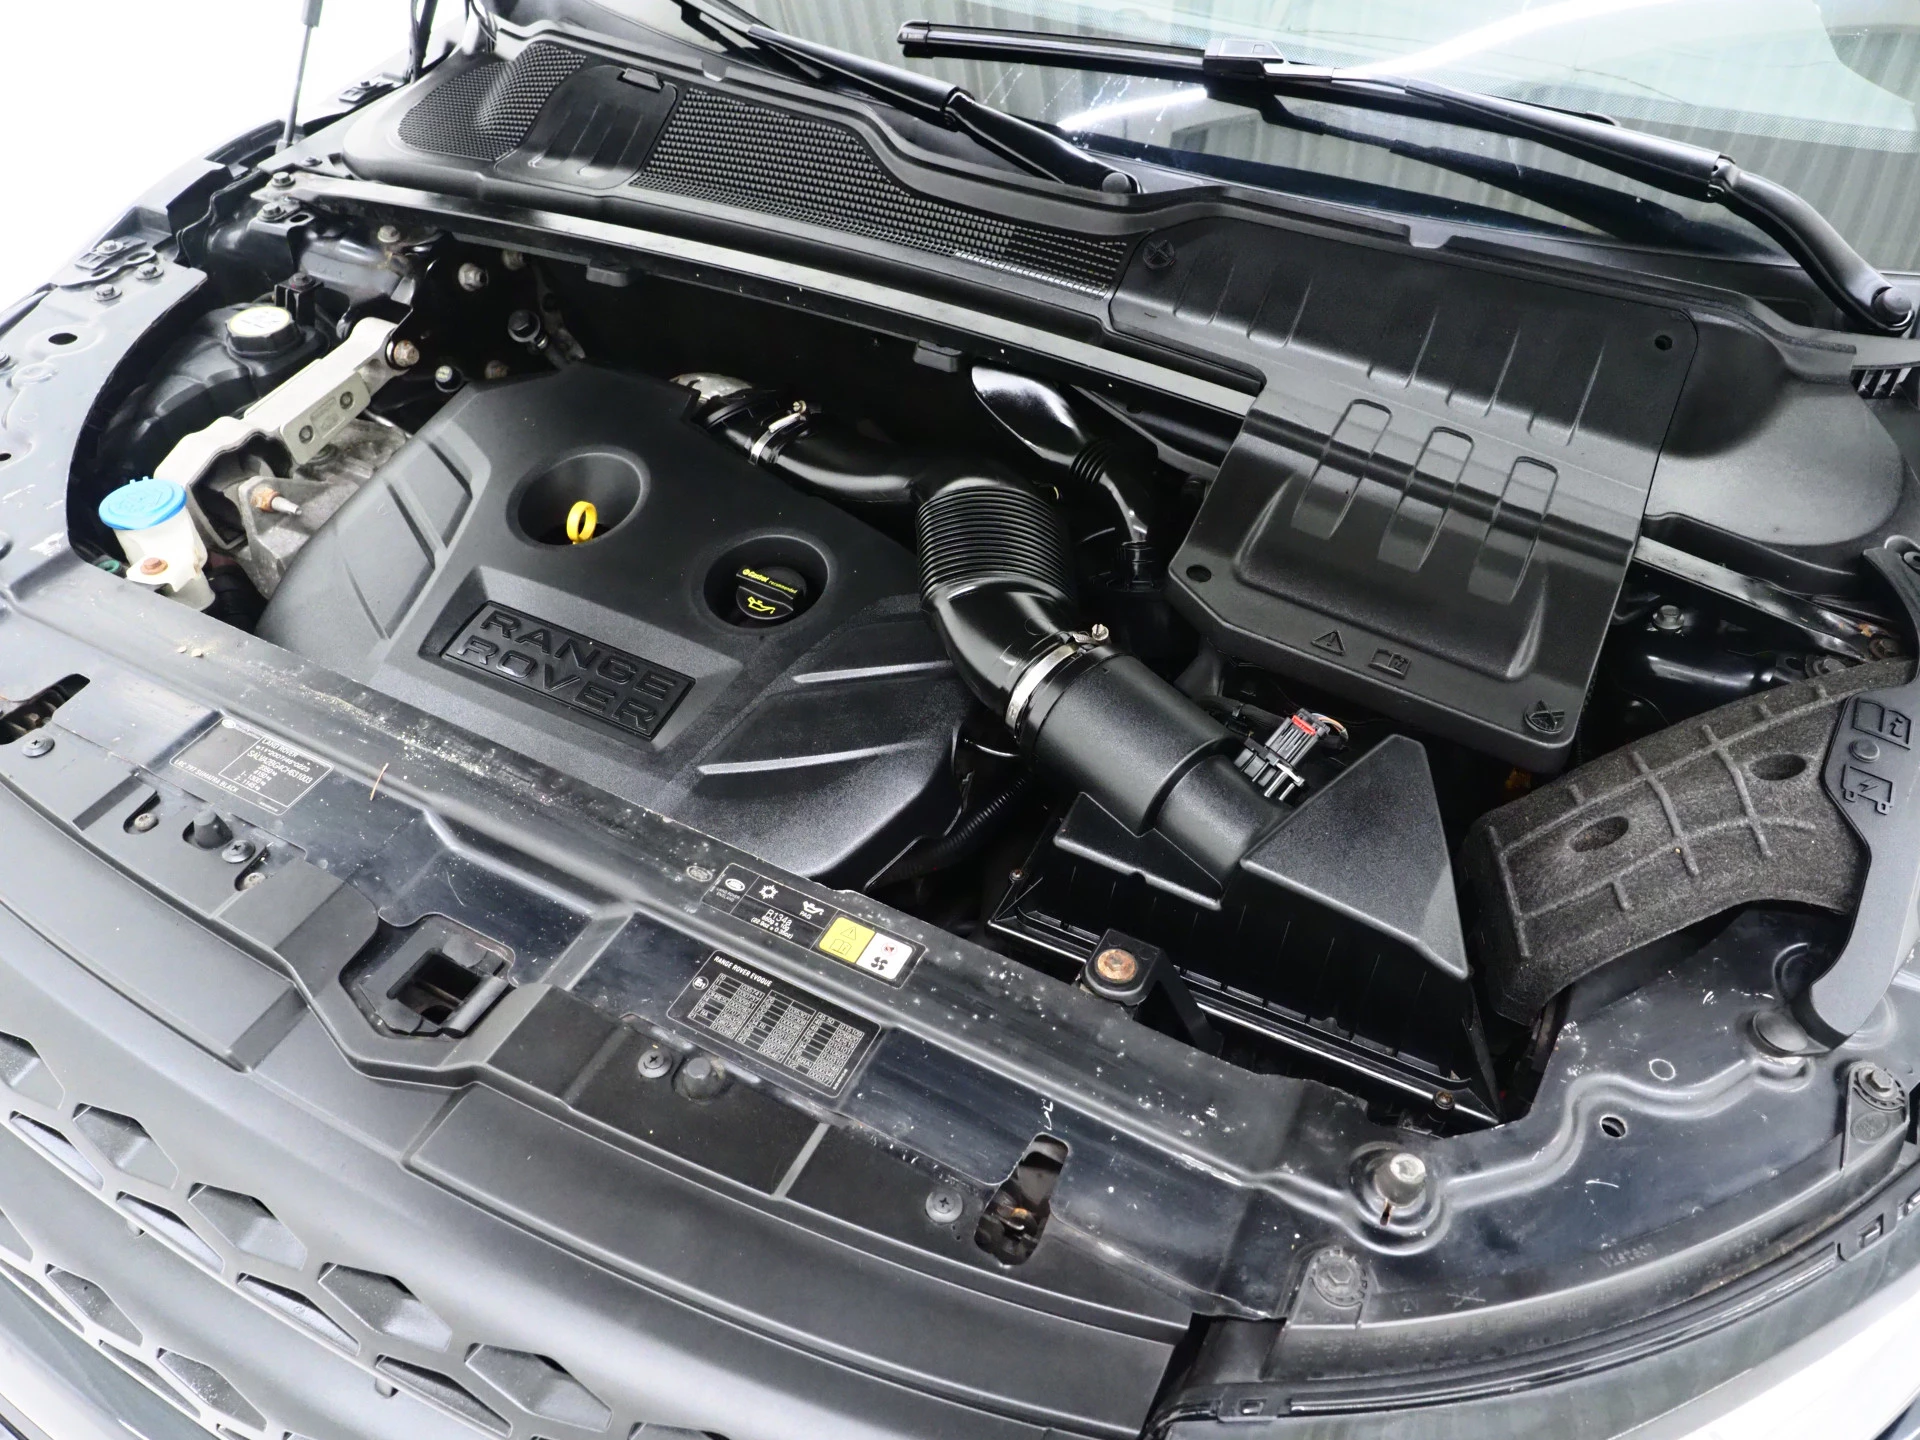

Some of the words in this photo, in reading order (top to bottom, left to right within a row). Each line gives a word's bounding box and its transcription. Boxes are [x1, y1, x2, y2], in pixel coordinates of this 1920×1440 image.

[480, 609, 678, 700] RANGE
[457, 635, 658, 734] ROVER
[262, 739, 282, 750] LAND
[278, 746, 299, 758] ROVER
[195, 769, 221, 784] SUMATRA
[219, 781, 239, 792] BLACK
[764, 908, 793, 926] R134a
[799, 911, 812, 920] PAG
[713, 955, 733, 969] RANGE
[731, 964, 751, 977] ROVER
[749, 972, 773, 987] EVOQUE
